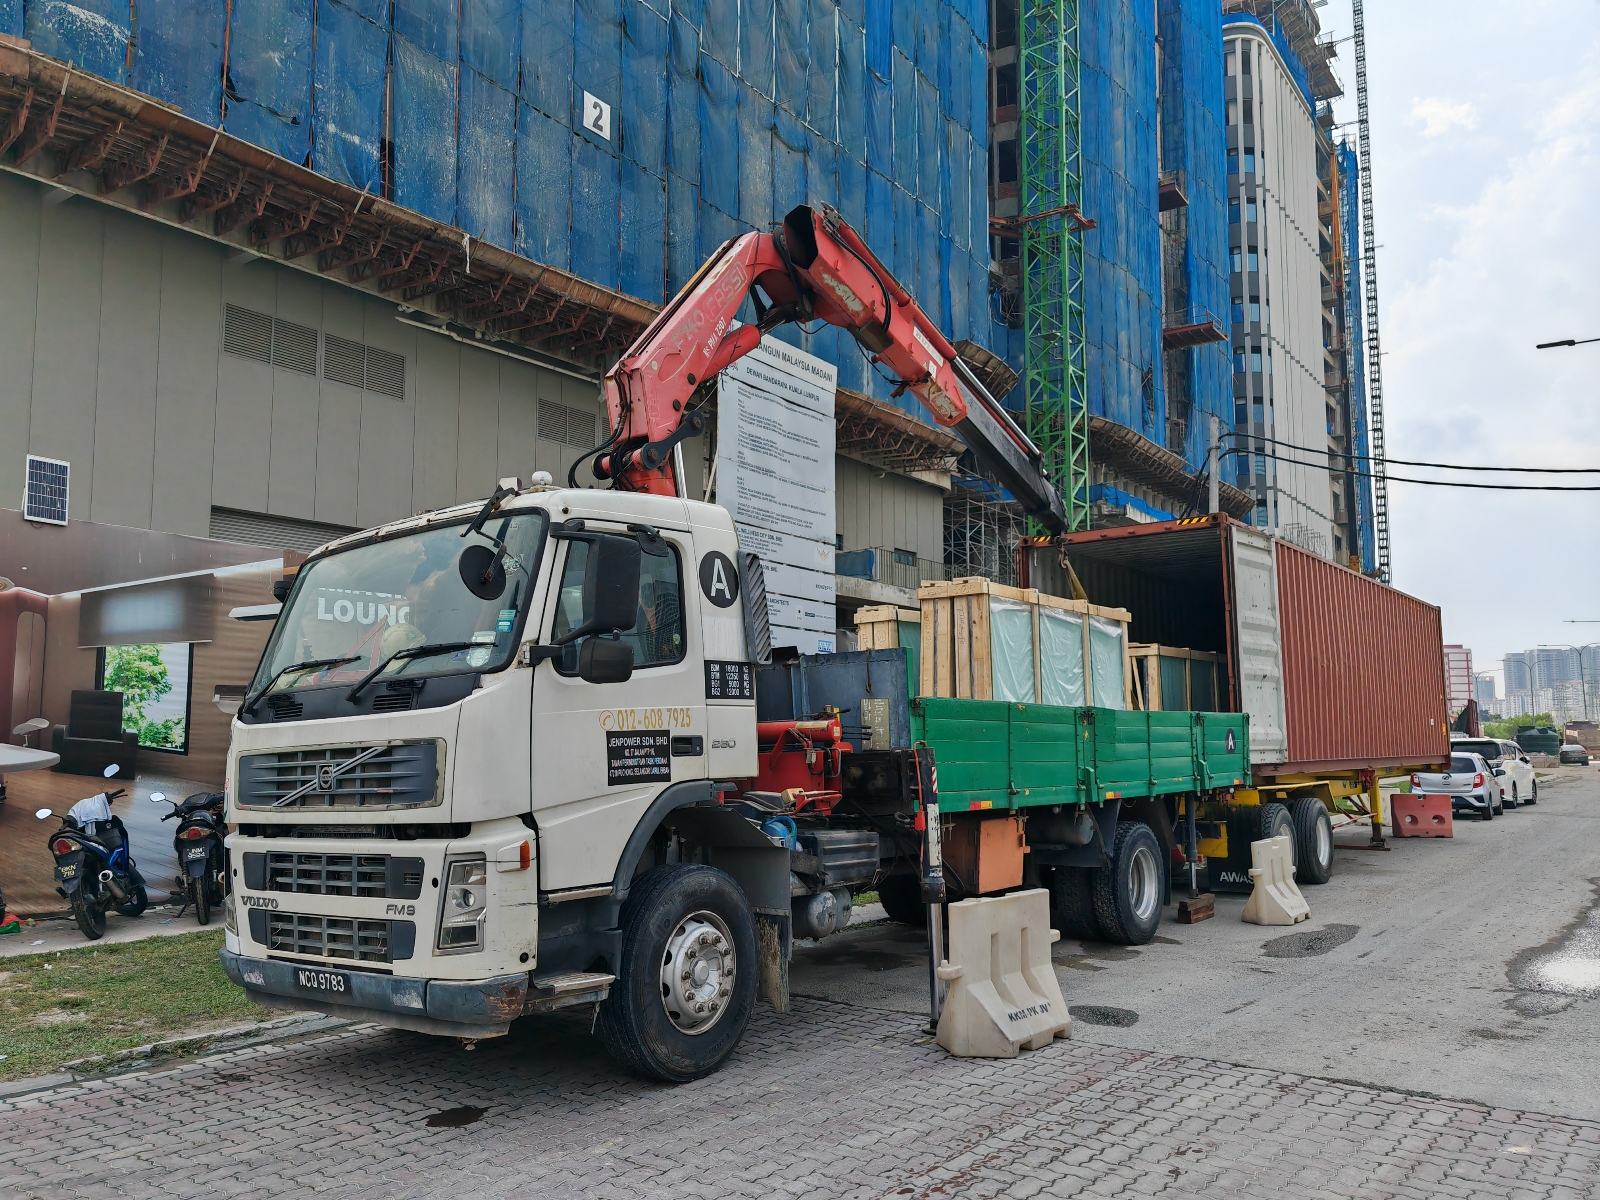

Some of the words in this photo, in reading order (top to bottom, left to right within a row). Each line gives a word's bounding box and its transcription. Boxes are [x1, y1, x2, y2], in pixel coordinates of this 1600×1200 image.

[592, 101, 604, 133] 2
[705, 265, 746, 319] FASSI
[757, 343, 781, 359] ANGUN
[782, 351, 811, 371] MALAYSIA
[811, 366, 833, 383] MADANI
[746, 366, 762, 380] DEWAN
[763, 373, 788, 391] BANDARAYA
[788, 384, 803, 396] KUALA
[803, 389, 820, 403] LUMPUR
[711, 558, 731, 600] A
[617, 708, 664, 730] 012-608
[666, 707, 692, 729] 7925
[608, 737, 641, 748] JENPOWER
[1228, 732, 1235, 751] A
[1219, 871, 1254, 884] AWAS
[241, 895, 279, 909] VOLVO
[386, 903, 416, 916] FM9
[298, 970, 318, 988] NCQ
[319, 973, 345, 992] 9783
